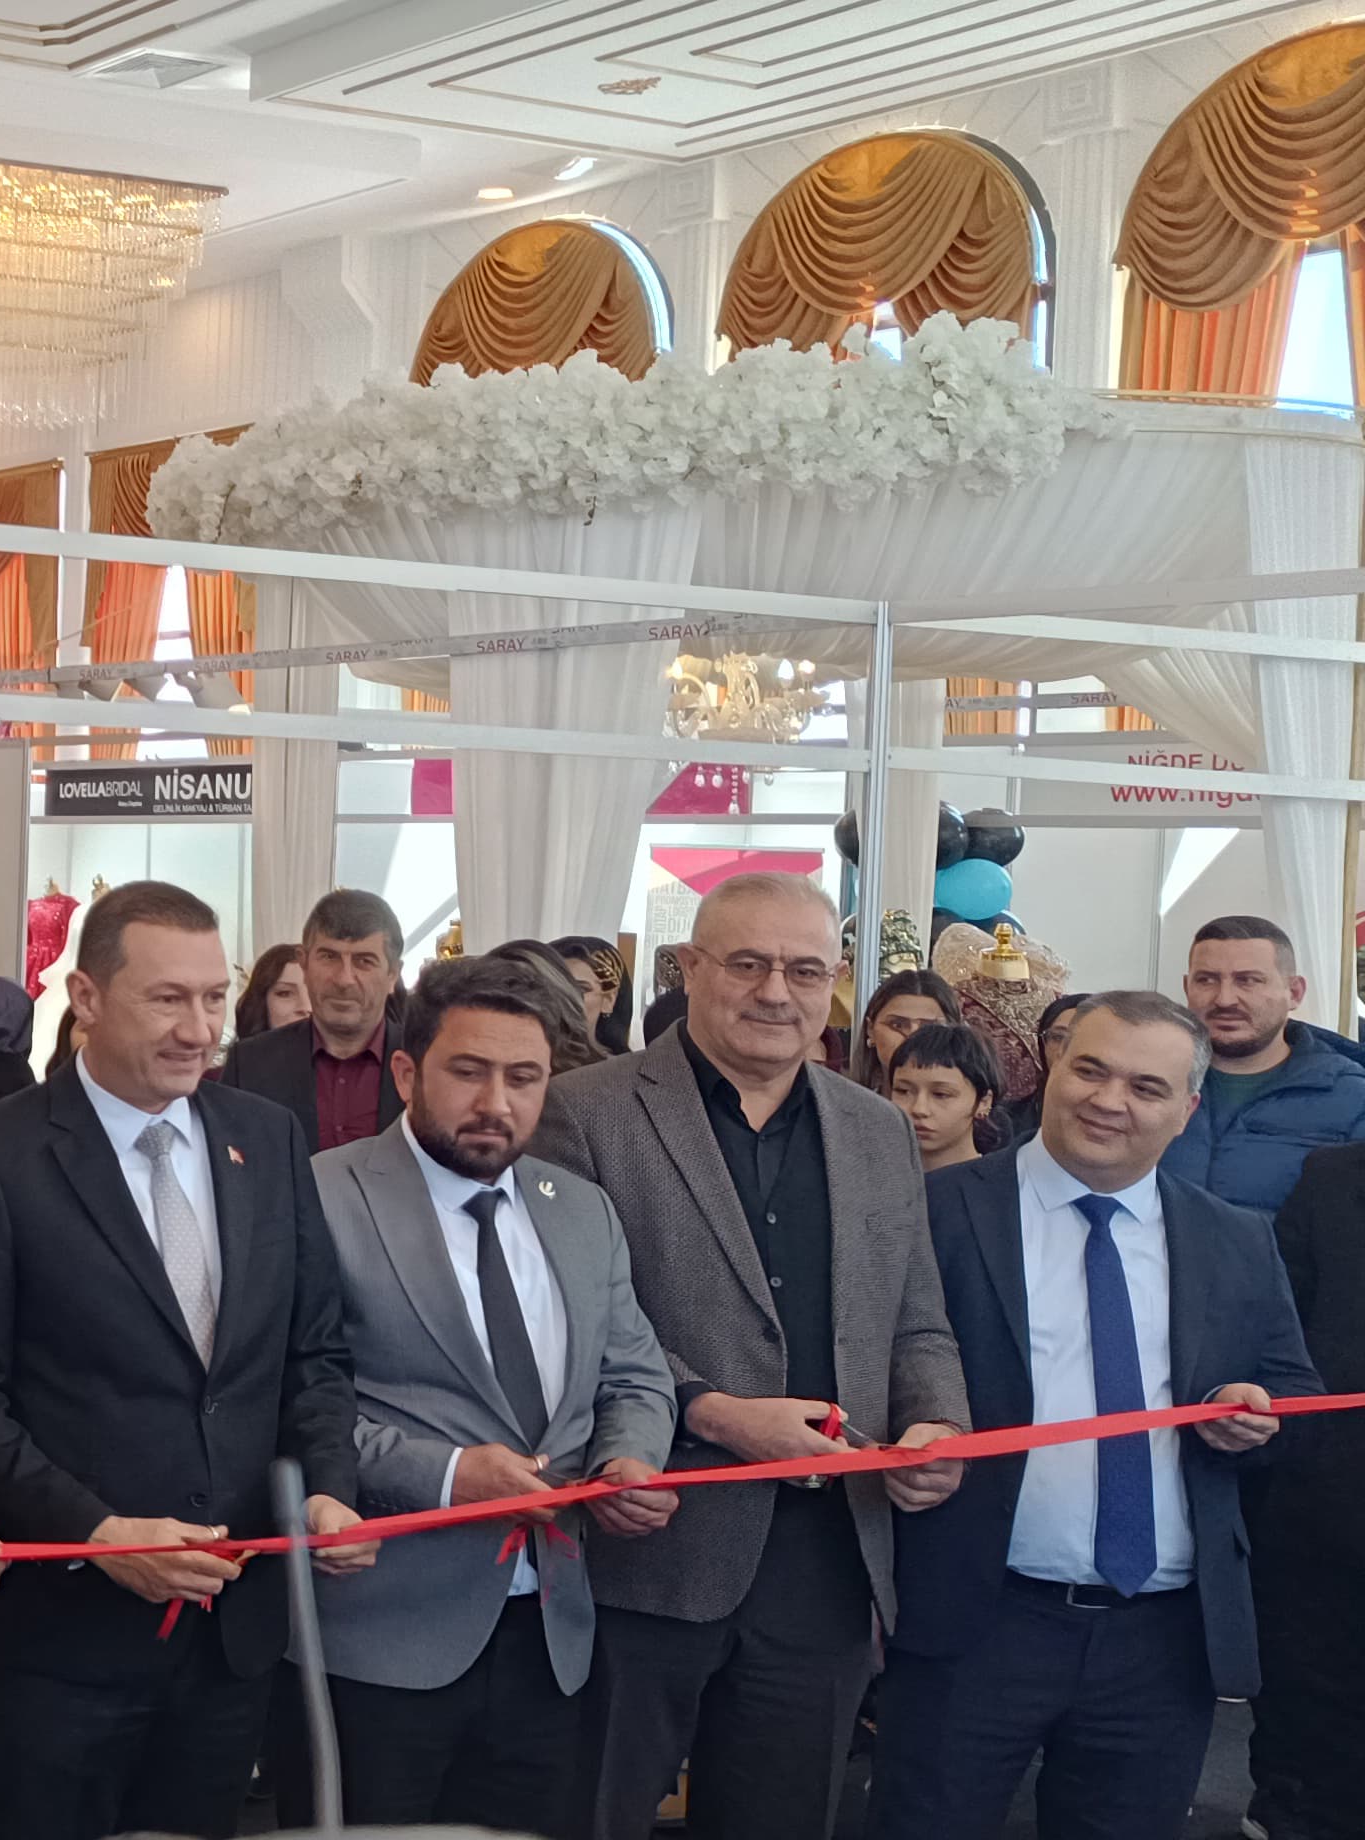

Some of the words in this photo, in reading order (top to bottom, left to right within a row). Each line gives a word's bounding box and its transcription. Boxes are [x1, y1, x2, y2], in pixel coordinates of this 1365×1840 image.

[648, 624, 703, 641] SARAY
[476, 638, 526, 654] SARAY
[325, 650, 369, 664] SARAY
[154, 768, 252, 801] NİSANU
